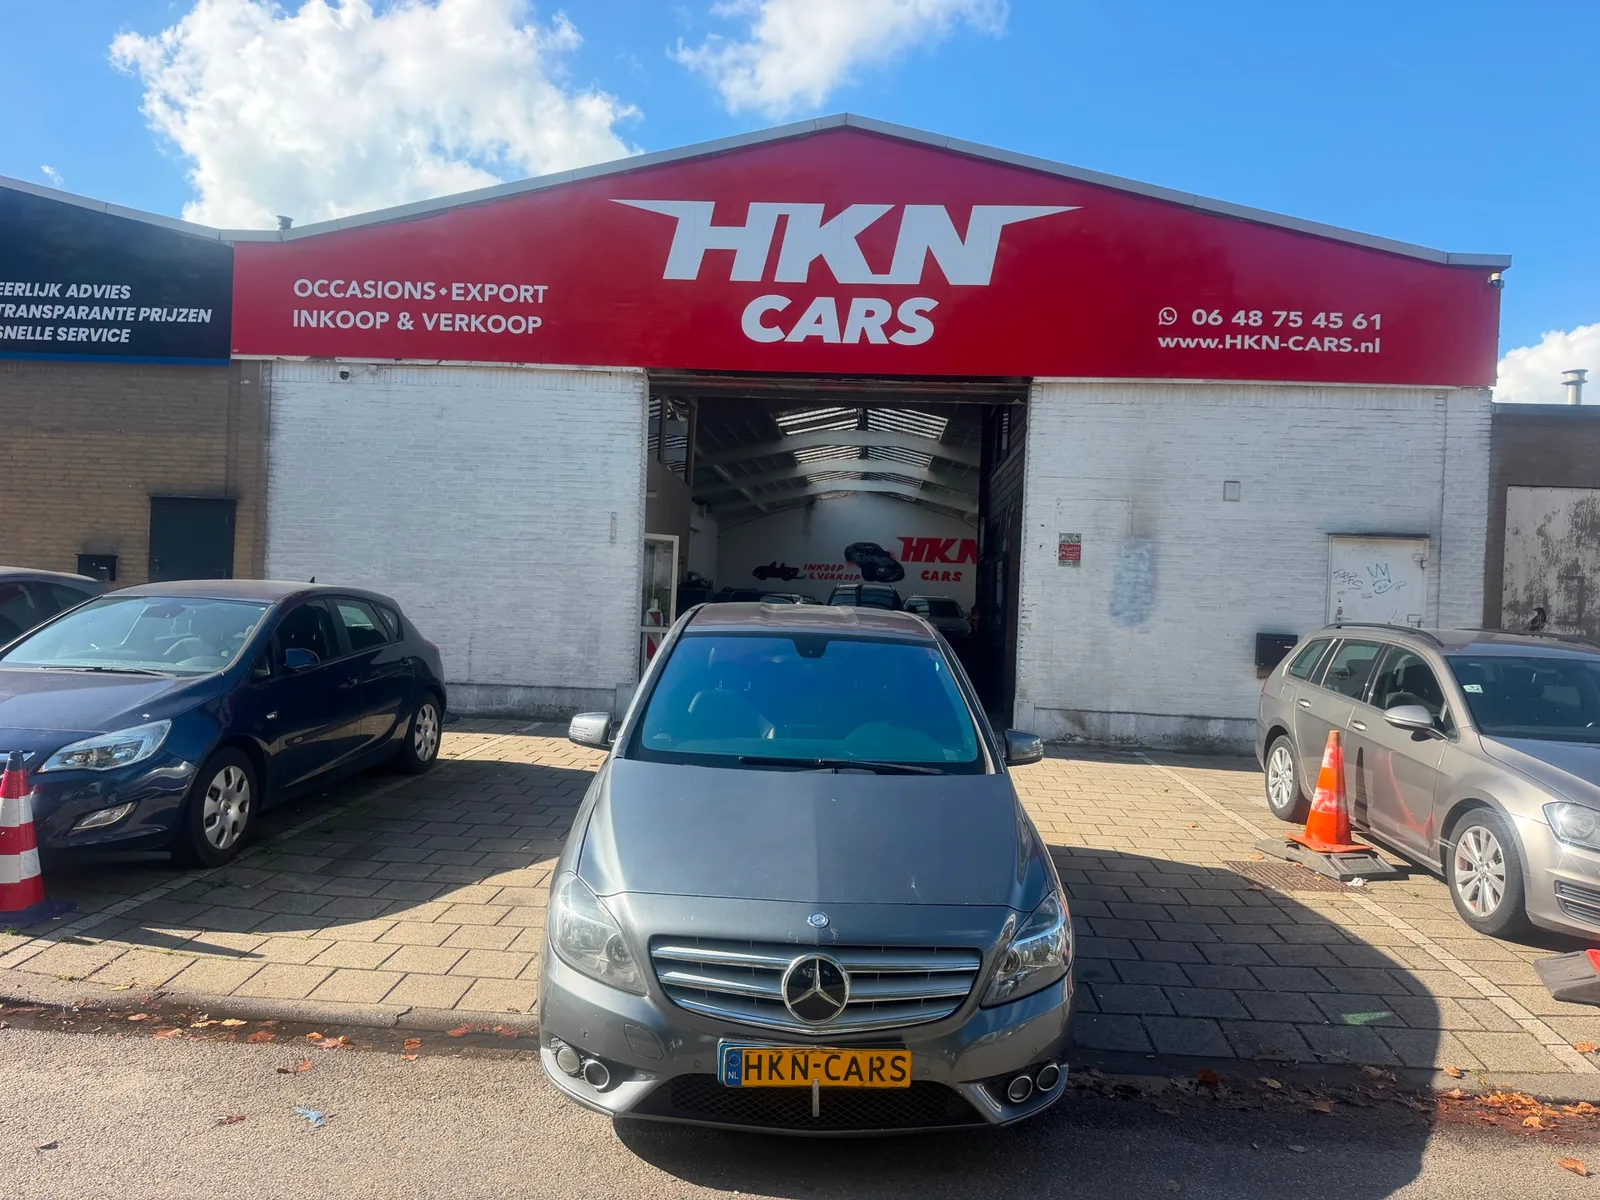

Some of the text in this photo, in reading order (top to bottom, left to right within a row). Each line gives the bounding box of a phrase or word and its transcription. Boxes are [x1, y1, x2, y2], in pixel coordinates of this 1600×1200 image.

[608, 199, 1084, 286] HKN
[65, 284, 131, 300] ADVIES
[293, 278, 549, 304] OCCASIONS EXPORT
[138, 307, 213, 323] PRIJZEN
[293, 309, 543, 335] INKOOP & VERKOOP
[741, 294, 940, 346] CARS
[1192, 308, 1382, 331] 06 48 75 45 61
[56, 326, 131, 343] SERVICE
[1158, 334, 1380, 354] www.HKN-CARS.nl
[803, 563, 844, 572] INKOOP
[808, 571, 861, 581] & VERKOOP
[920, 570, 963, 582] CARS
[728, 1054, 907, 1083] NL HKN-CARS
